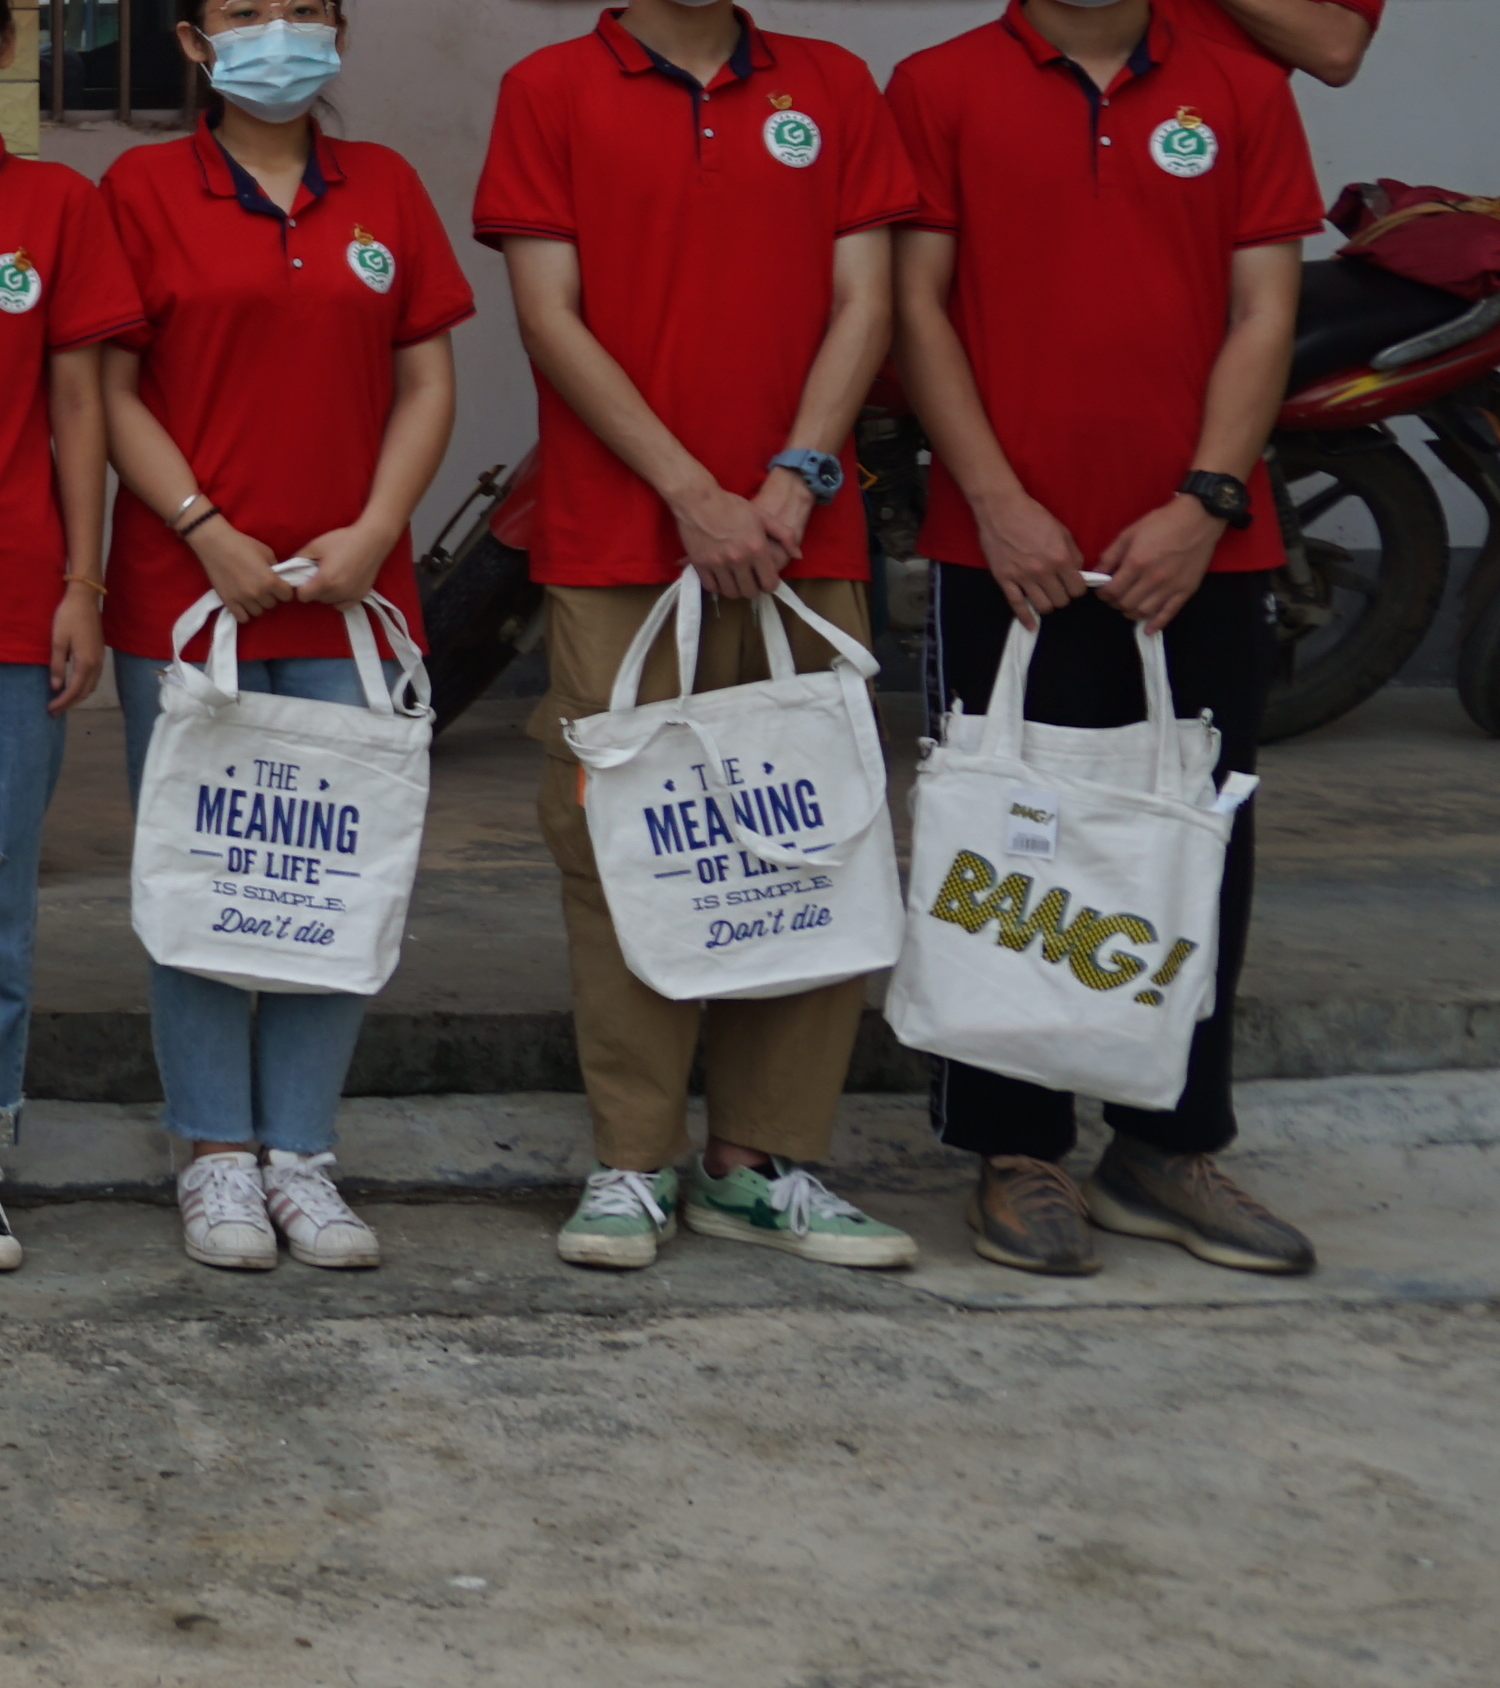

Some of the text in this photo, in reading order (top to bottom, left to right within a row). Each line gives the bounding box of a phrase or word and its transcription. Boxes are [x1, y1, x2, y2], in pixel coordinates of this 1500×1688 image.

[254, 759, 300, 791] THE
[691, 758, 744, 791] TE
[195, 784, 360, 855] MEANING
[643, 779, 824, 855] MEANING
[227, 846, 321, 885] OF LIFE
[697, 855, 729, 884] OF
[212, 880, 237, 895] IS
[692, 895, 720, 910] IS
[212, 907, 335, 945] Don't die
[706, 904, 833, 949] Don't die
[929, 849, 1198, 1006] BANG!
